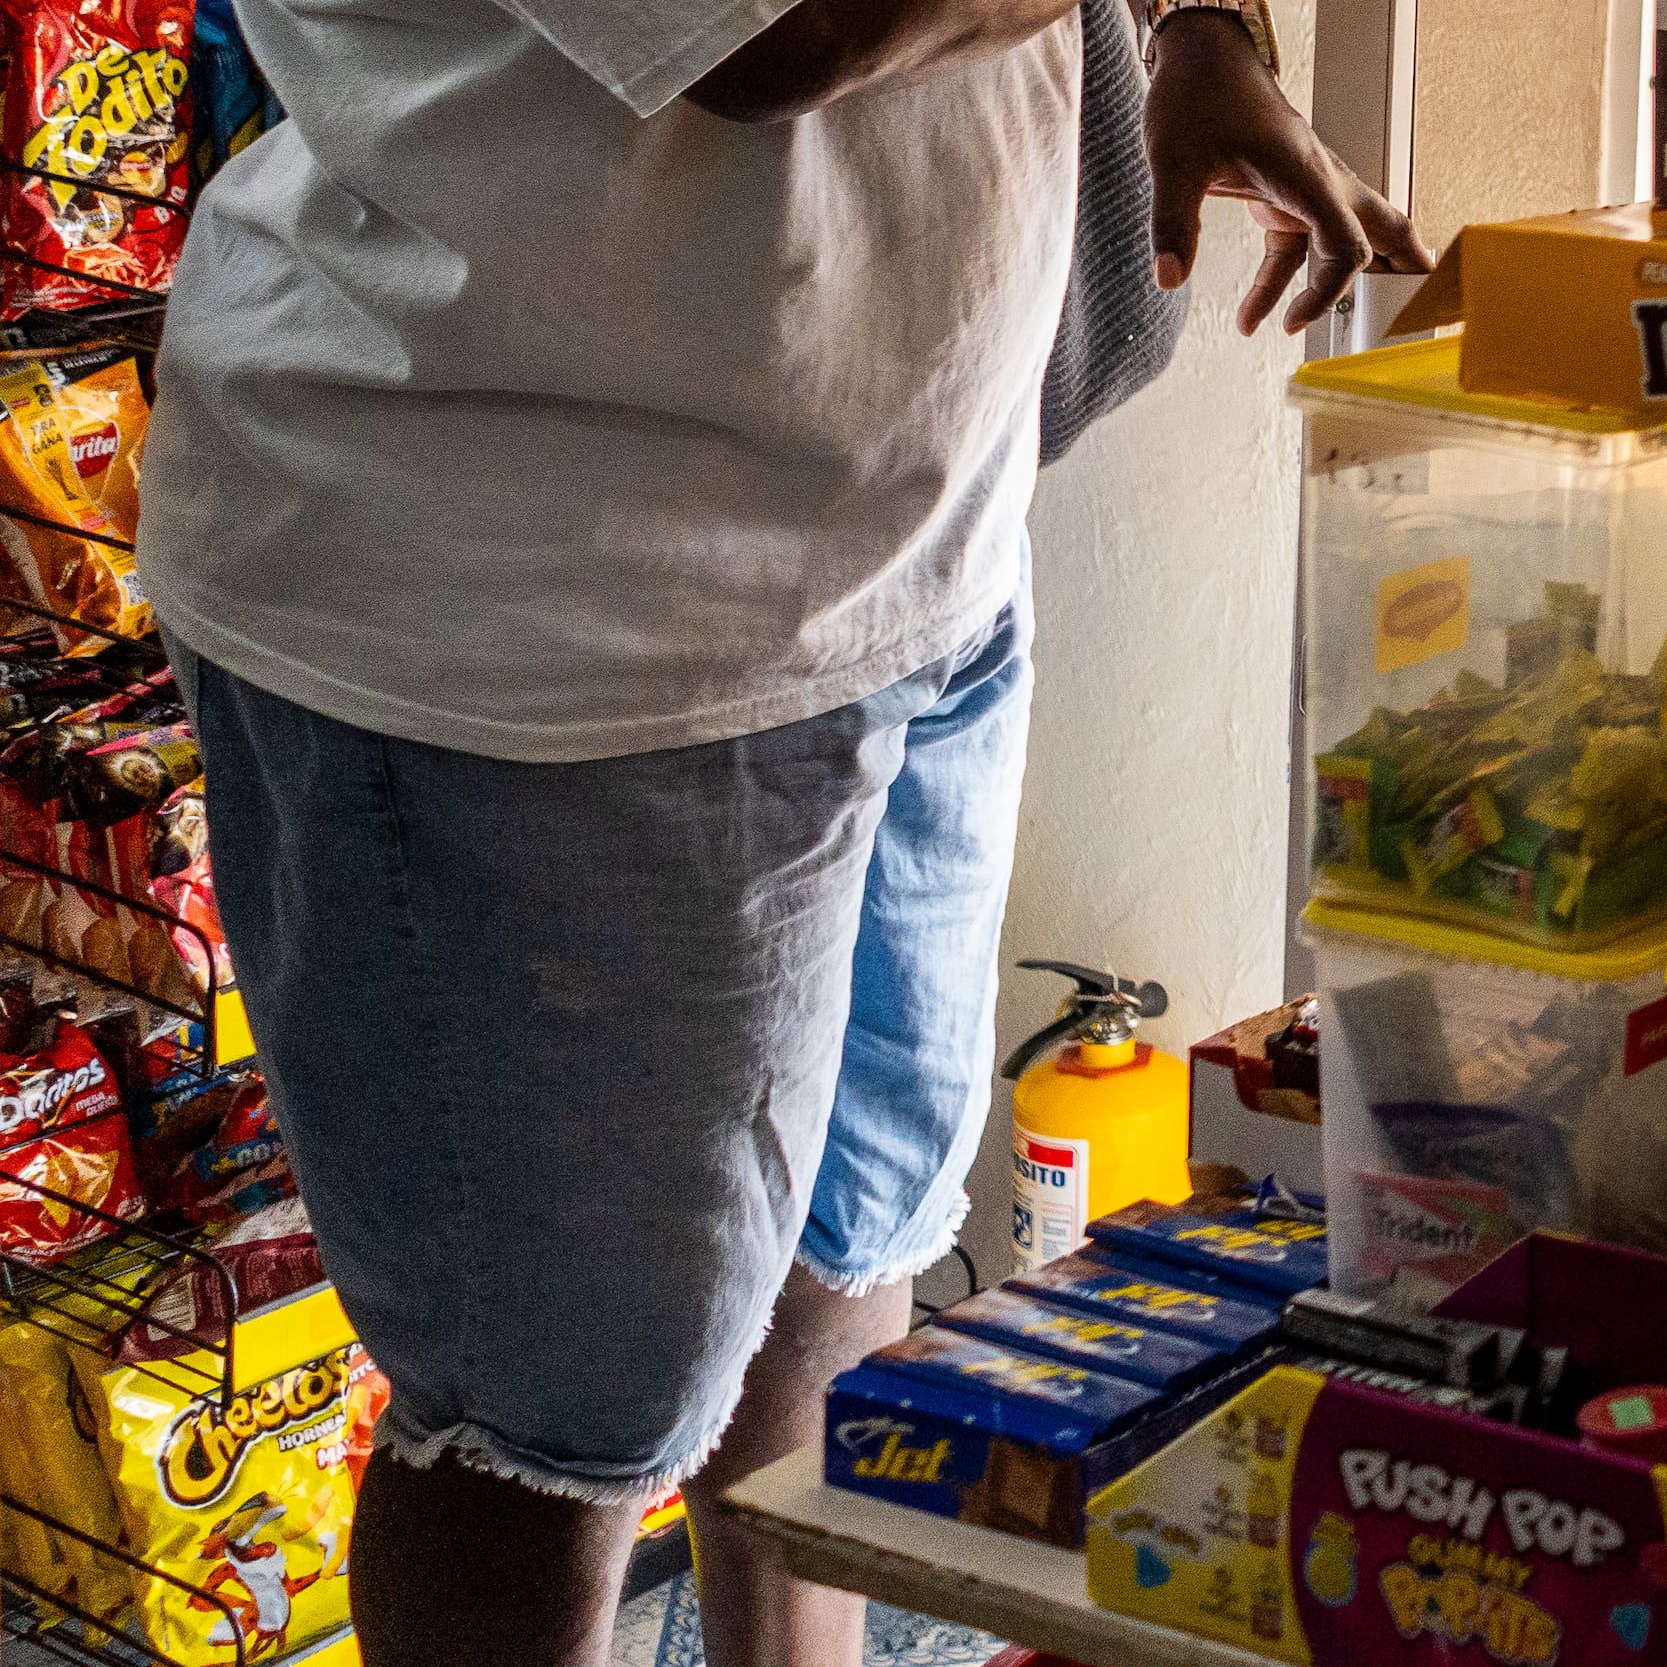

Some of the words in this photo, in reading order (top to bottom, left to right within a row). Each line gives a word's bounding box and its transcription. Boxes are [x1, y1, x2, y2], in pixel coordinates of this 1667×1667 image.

[59, 46, 129, 114] De
[23, 49, 188, 214] Todito
[853, 1433, 952, 1484] Jet
[1337, 1446, 1496, 1539] PUSH
[1500, 1487, 1625, 1567] POP
